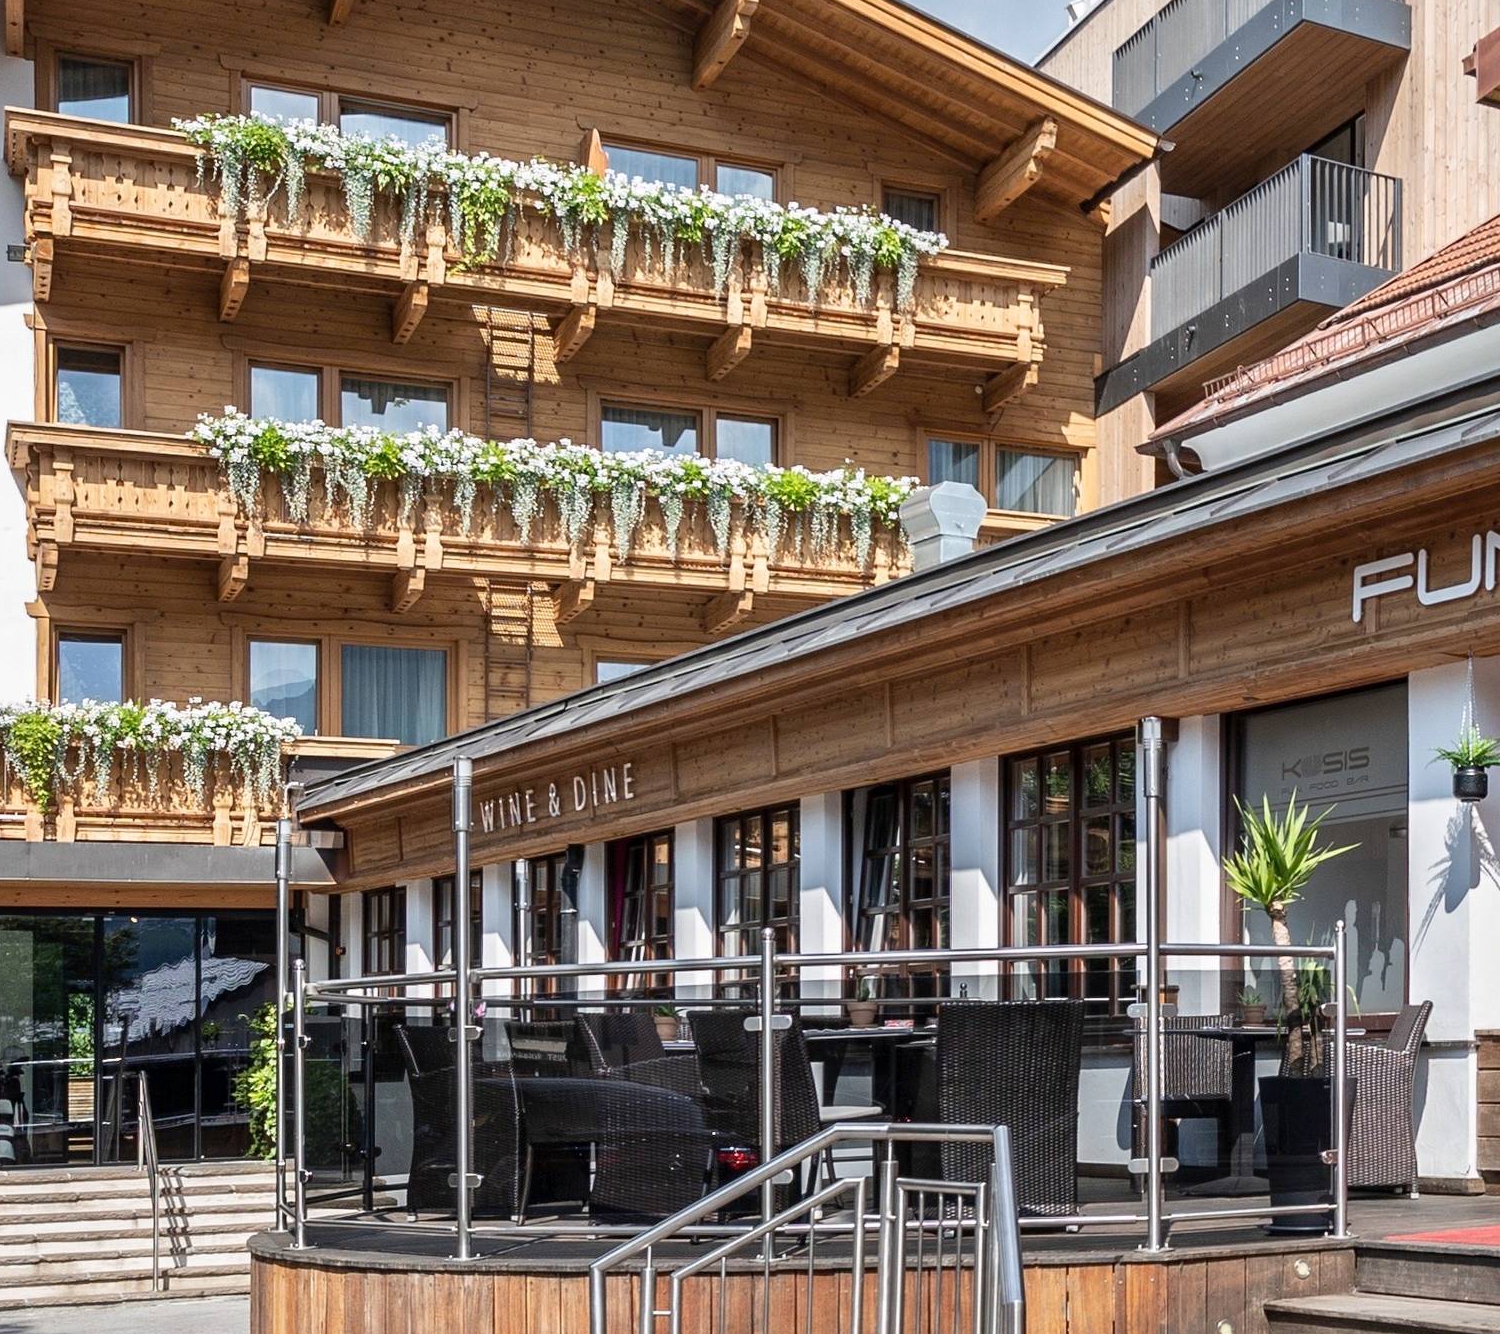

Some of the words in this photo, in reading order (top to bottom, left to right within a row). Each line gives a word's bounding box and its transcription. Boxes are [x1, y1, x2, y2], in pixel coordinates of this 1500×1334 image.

[479, 789, 537, 833] WINE
[548, 782, 561, 817] &
[573, 762, 634, 811] DINE
